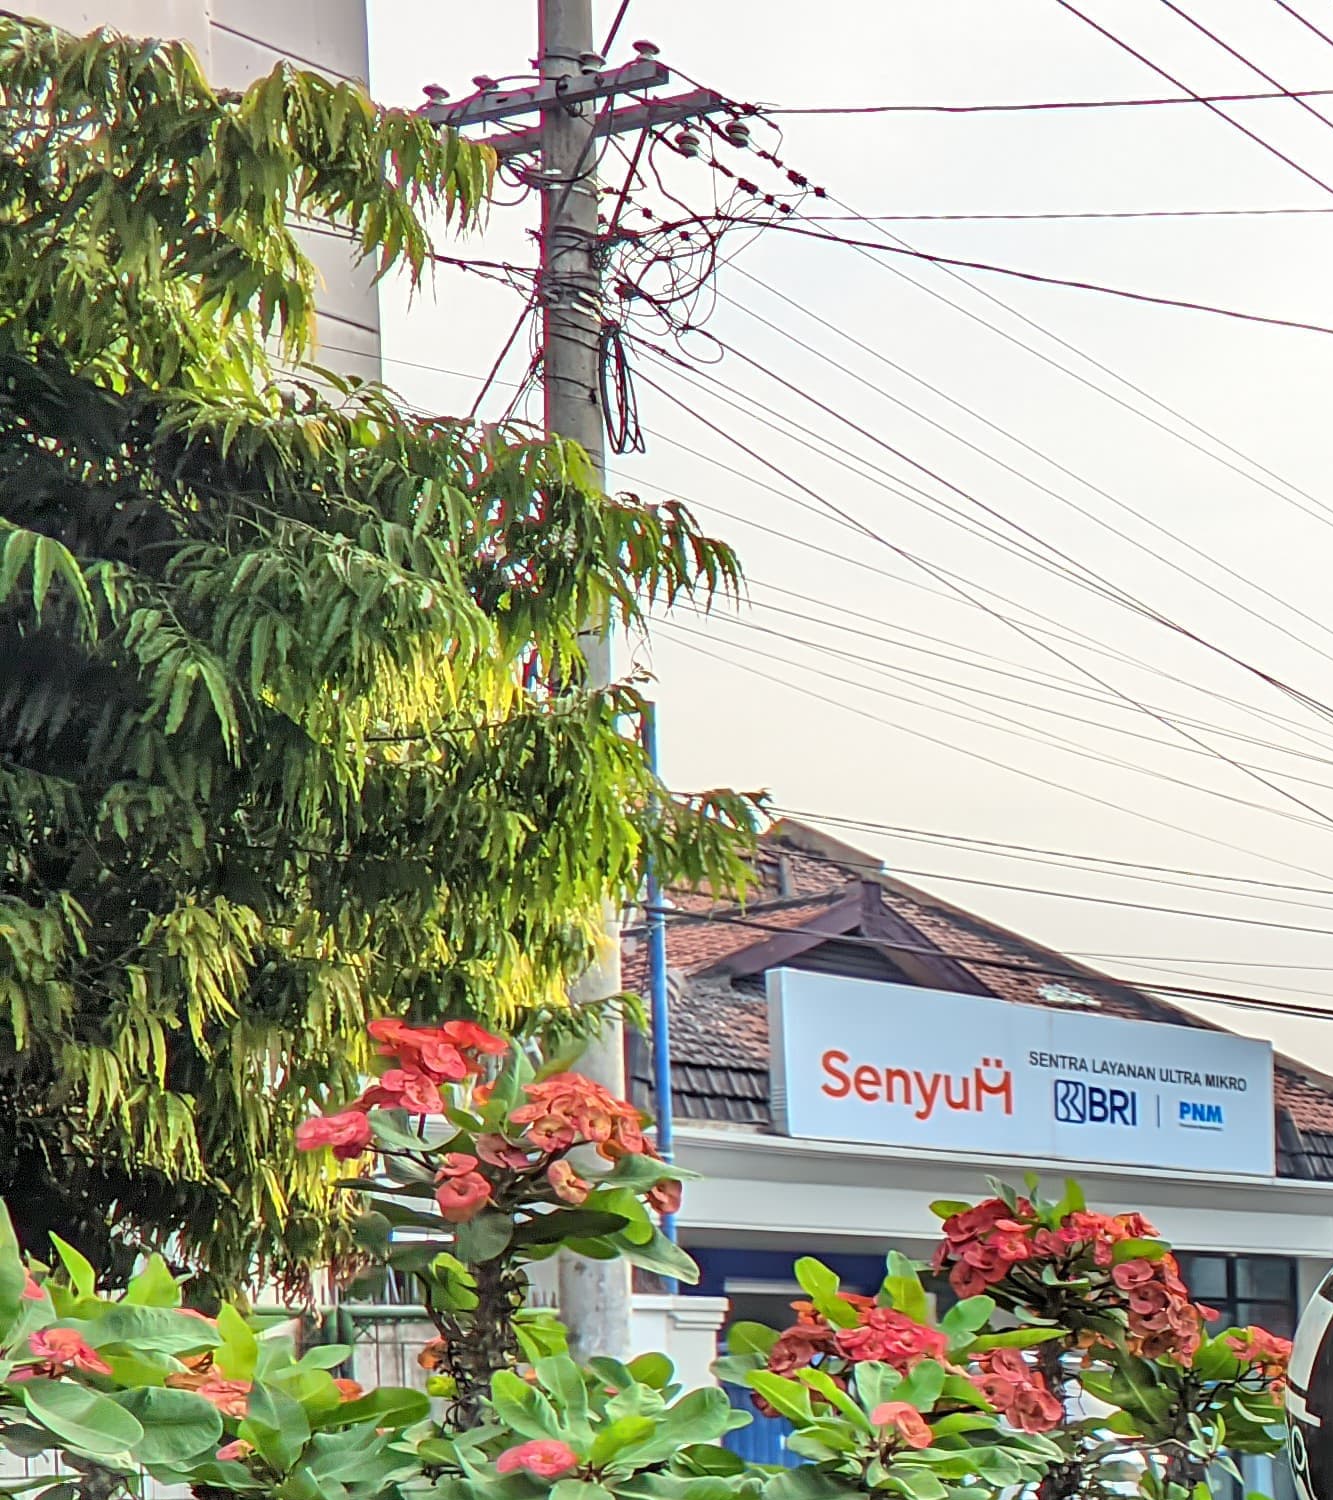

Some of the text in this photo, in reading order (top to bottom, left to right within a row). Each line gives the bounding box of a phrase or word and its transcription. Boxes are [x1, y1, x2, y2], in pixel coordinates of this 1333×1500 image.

[1029, 1051, 1247, 1092] SENTRA LAYANAN ULTRA MIKRO
[1088, 1087, 1223, 1126] BRI PNM
